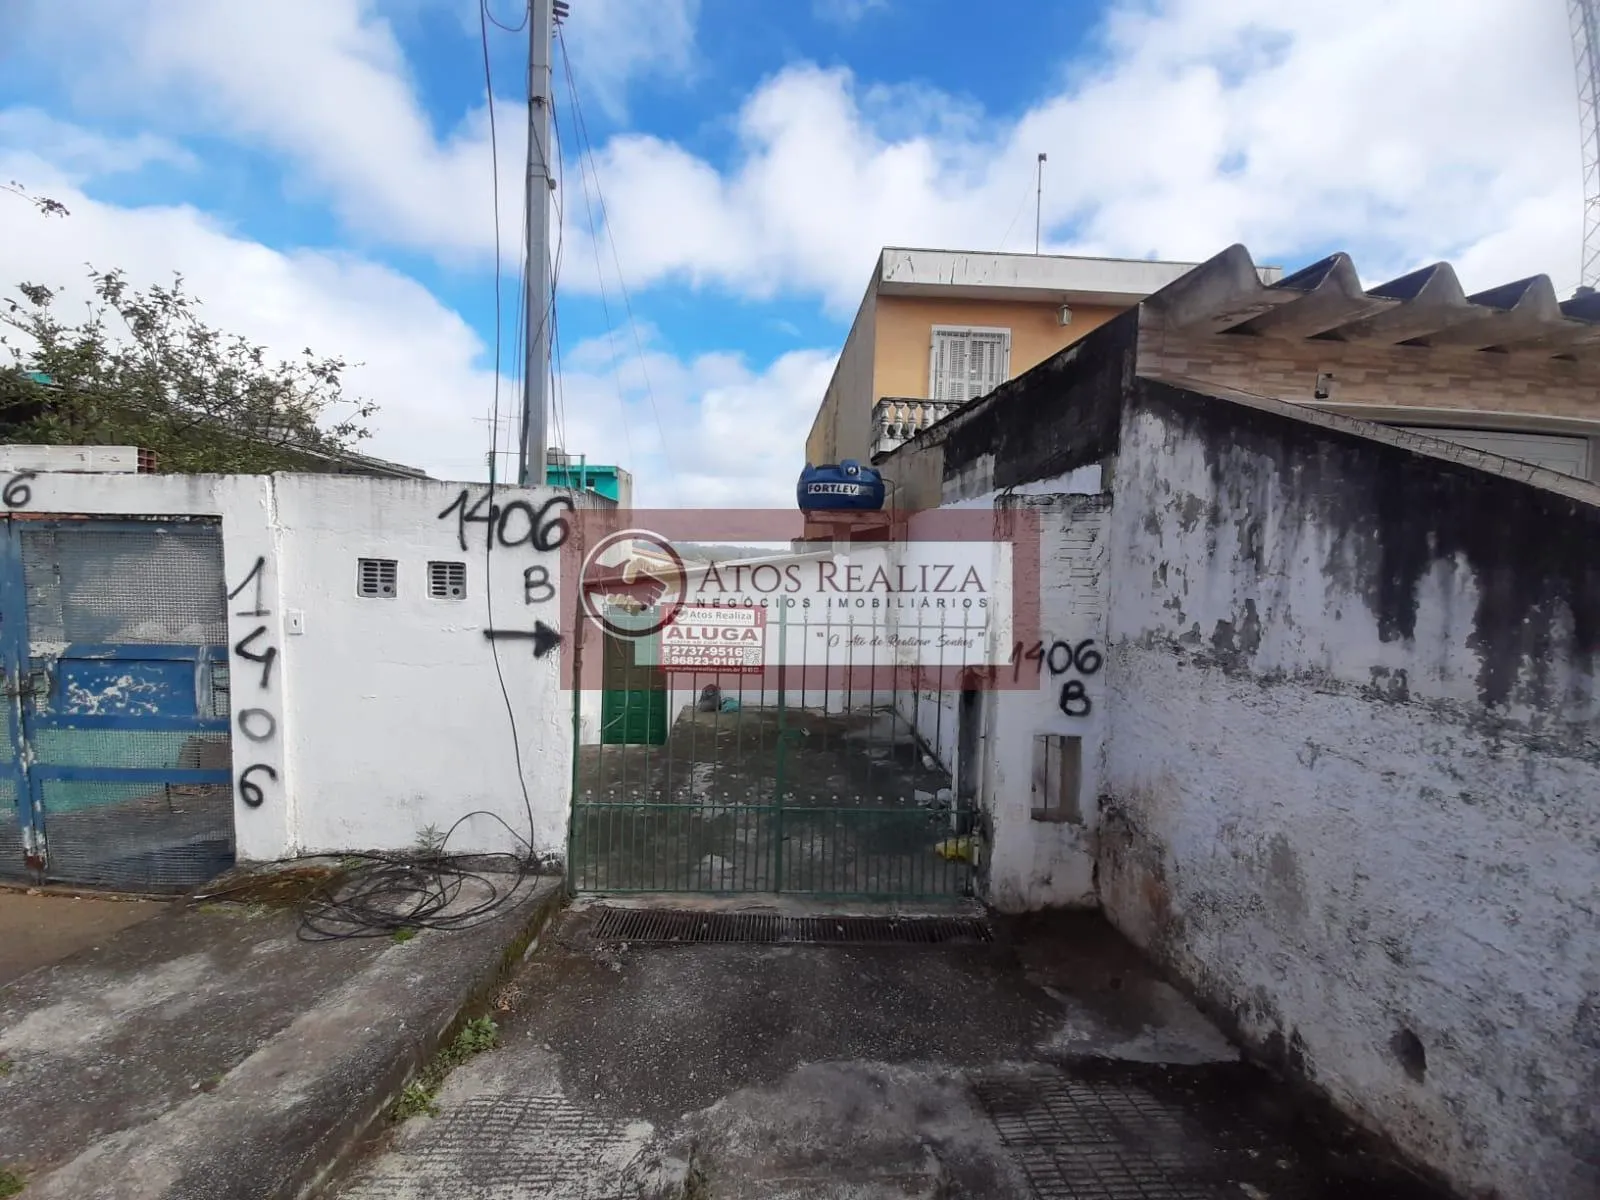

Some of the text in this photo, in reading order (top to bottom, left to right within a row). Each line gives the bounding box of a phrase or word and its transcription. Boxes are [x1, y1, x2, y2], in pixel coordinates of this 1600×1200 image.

[2, 469, 36, 508] 6
[808, 484, 857, 494] FORTLEV
[438, 489, 575, 552] 1406
[523, 565, 556, 605] B
[689, 611, 752, 621] Atos Realiza
[666, 627, 759, 642] ALUGA
[671, 646, 743, 657] 2737-9516
[671, 656, 743, 666] 96823-0187
[1010, 639, 1103, 684] 1406
[1059, 680, 1092, 717] B
